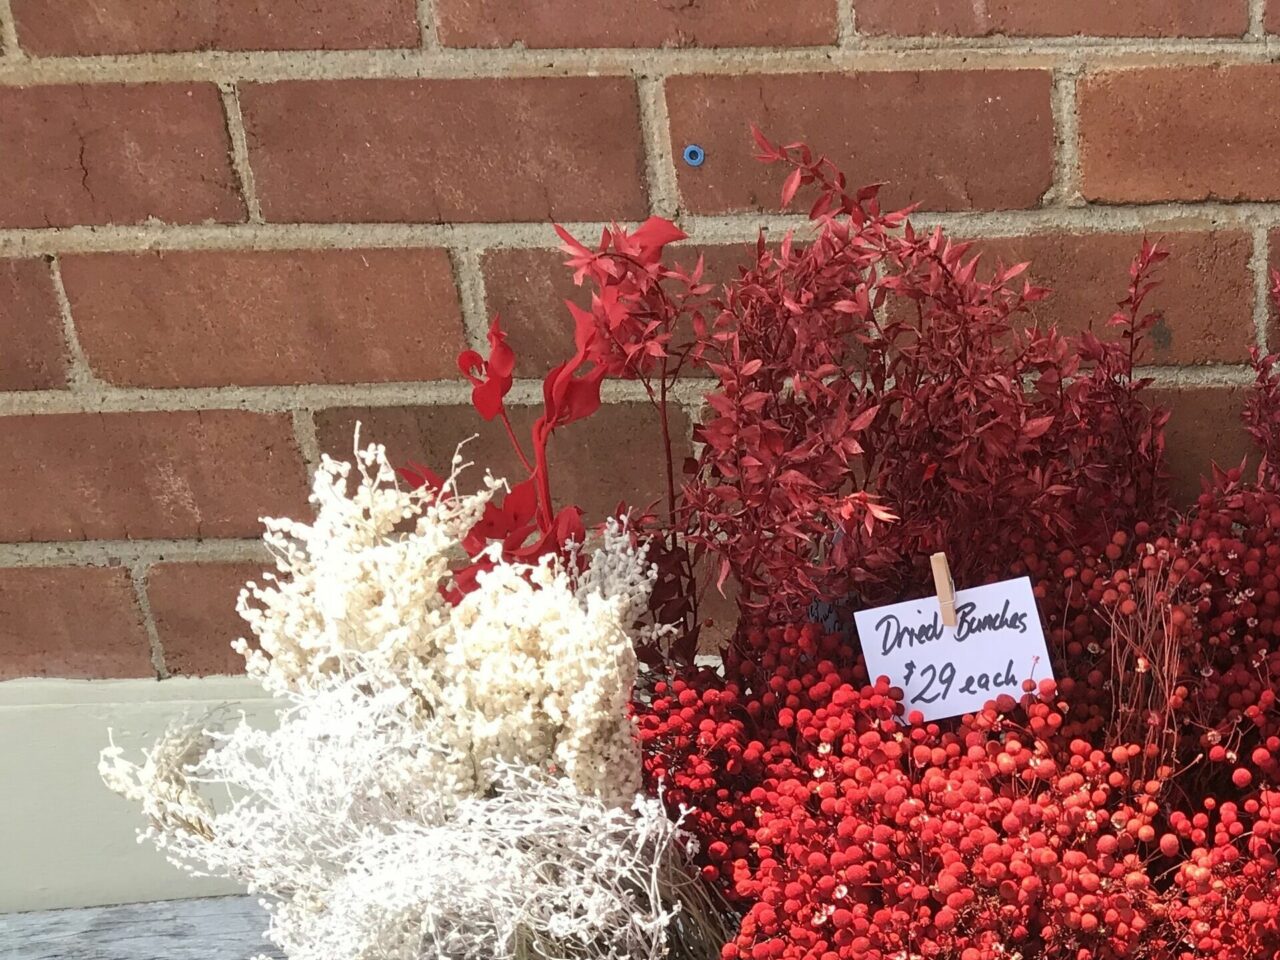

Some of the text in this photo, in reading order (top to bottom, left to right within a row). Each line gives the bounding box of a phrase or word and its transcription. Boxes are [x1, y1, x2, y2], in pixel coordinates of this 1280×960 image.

[875, 609, 944, 656] Dried
[953, 599, 1028, 642] Bunches
[903, 659, 1018, 704] $29 each
